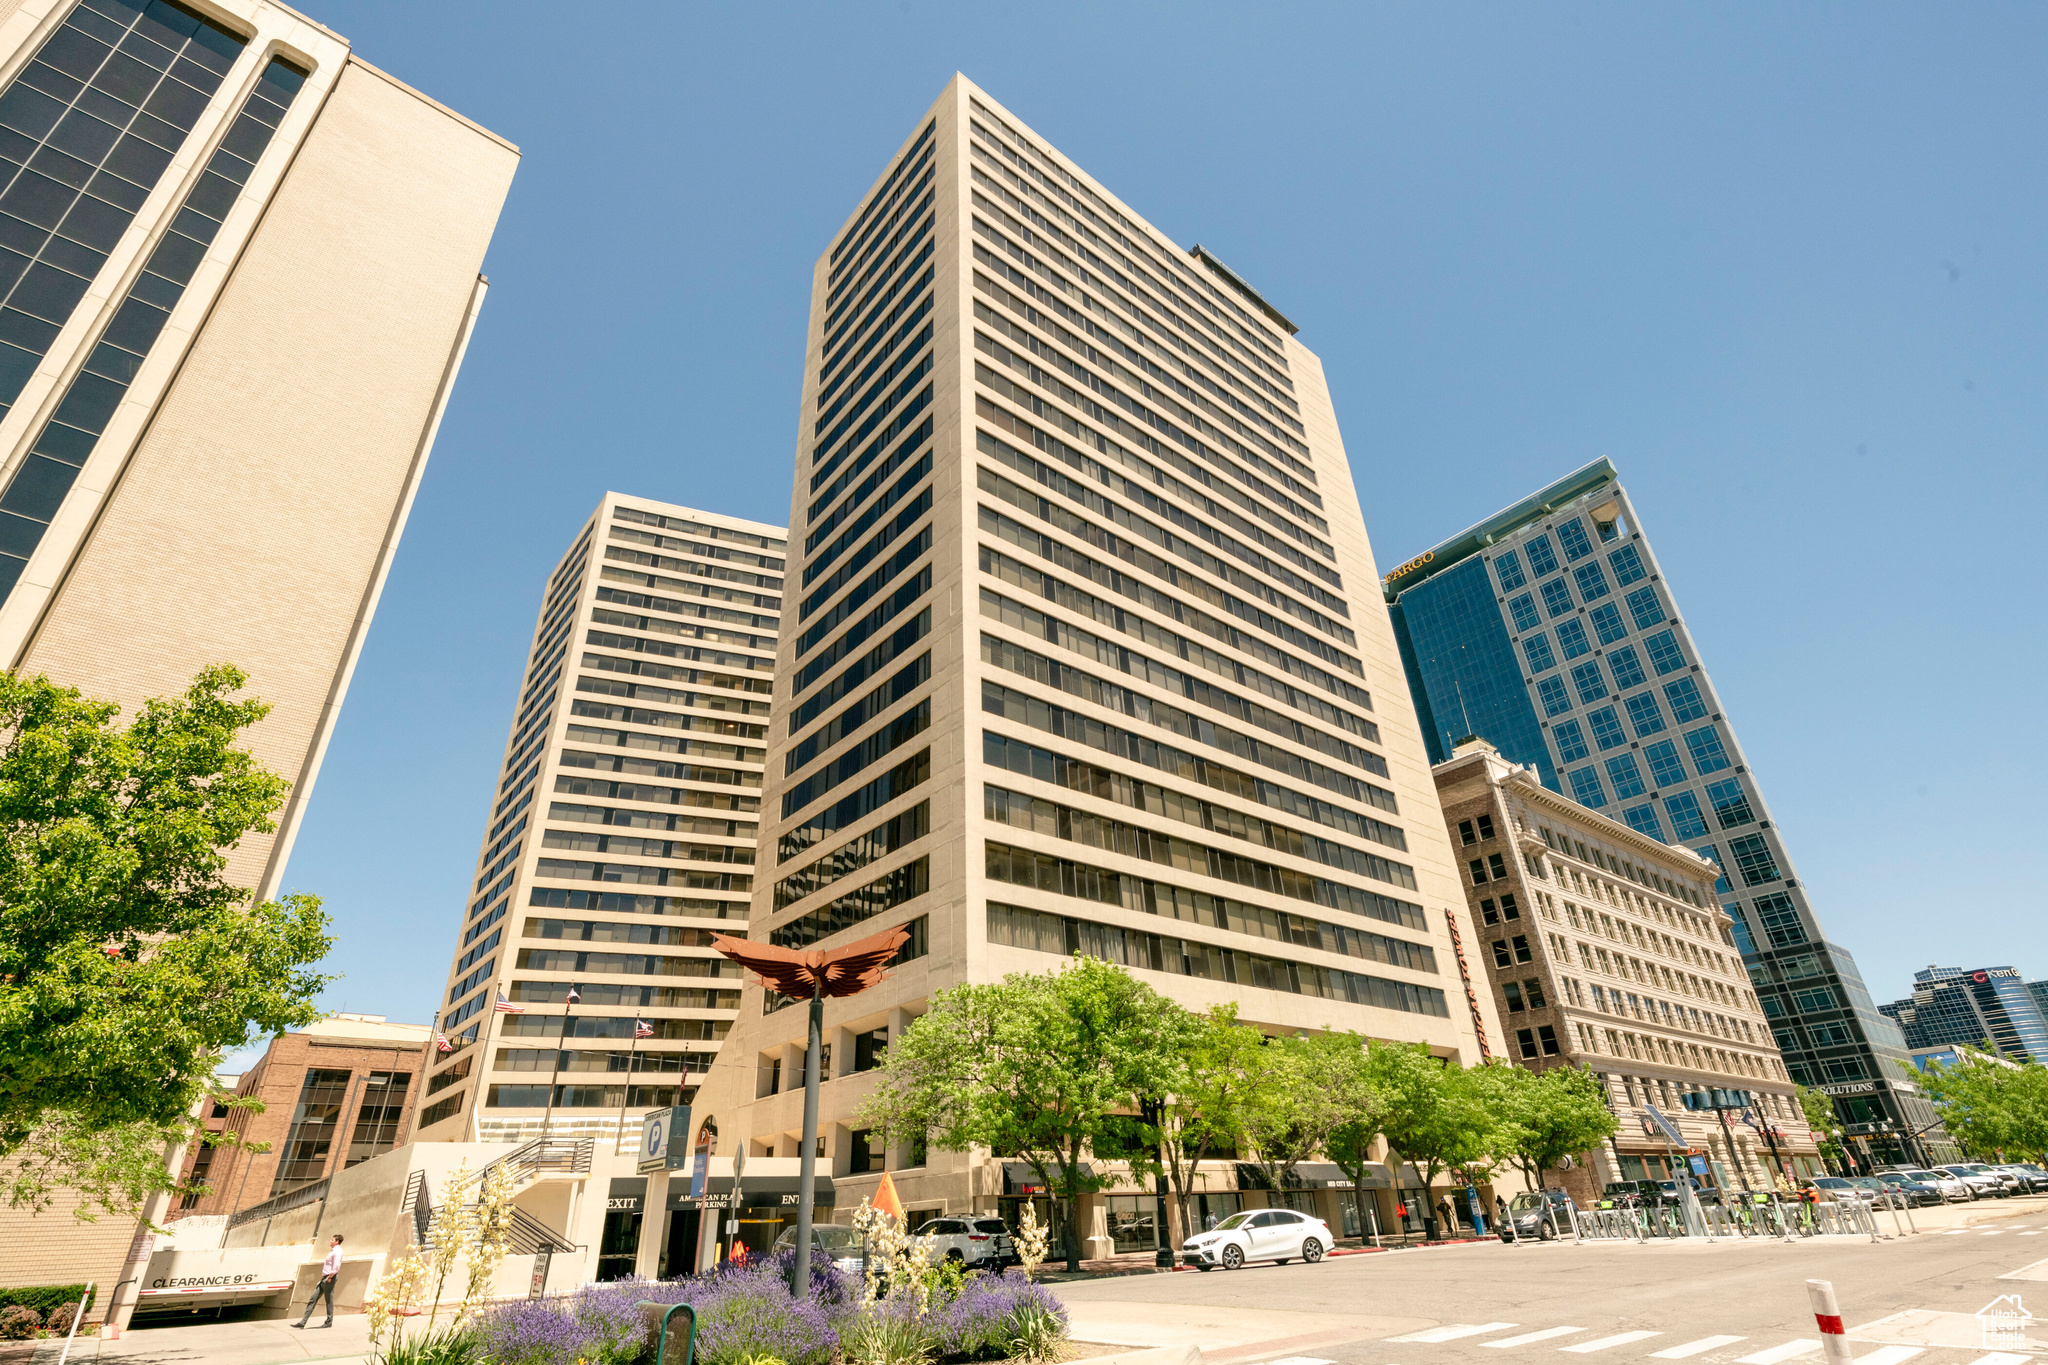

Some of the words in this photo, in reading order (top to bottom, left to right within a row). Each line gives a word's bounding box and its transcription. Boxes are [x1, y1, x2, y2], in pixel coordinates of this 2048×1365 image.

[1383, 551, 1435, 584] FARGO
[1445, 908, 1471, 981] TOWERS
[1466, 986, 1493, 1068] ERICAN
[1819, 1082, 1874, 1096] SOLUTIONS
[1022, 1183, 1034, 1194] kw
[606, 1197, 637, 1209] EXIT
[679, 1193, 719, 1202] AMCAN
[721, 1193, 744, 1201] PLAA
[781, 1194, 800, 1205] ENT
[152, 1276, 231, 1289] CLEARANCE
